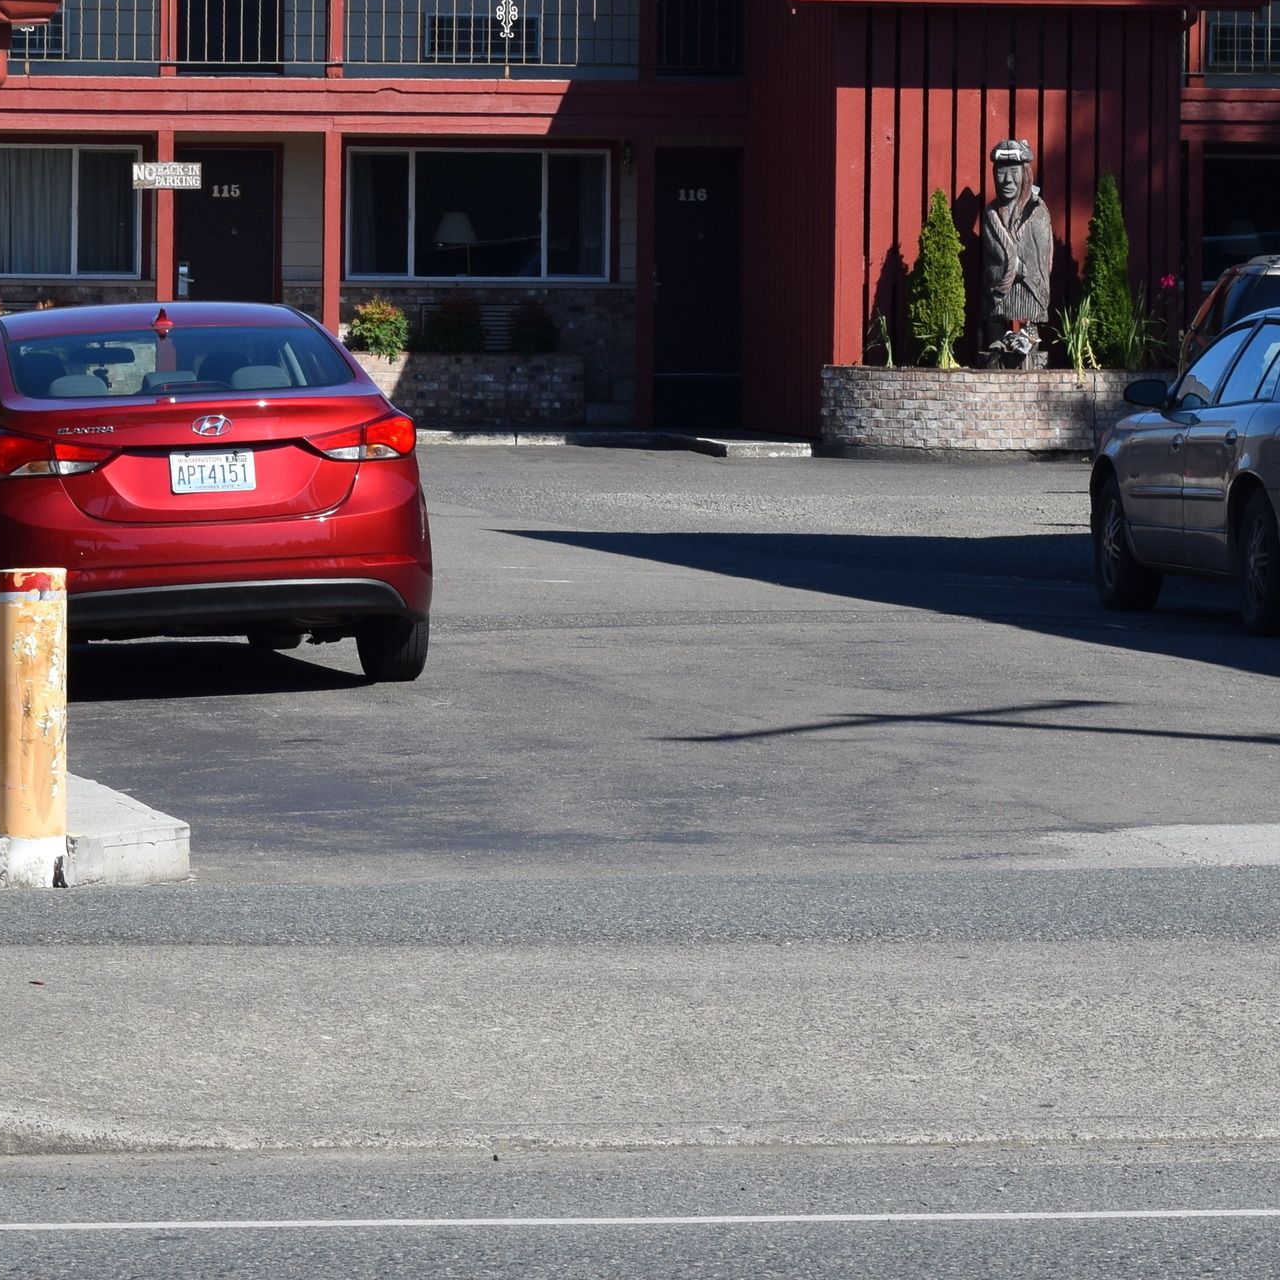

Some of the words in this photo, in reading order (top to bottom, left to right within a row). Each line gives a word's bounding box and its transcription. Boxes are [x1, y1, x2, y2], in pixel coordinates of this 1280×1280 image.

[133, 164, 157, 181] NO
[157, 164, 200, 175] BACK-IN
[155, 175, 201, 187] PARKING
[211, 184, 241, 198] 115
[676, 187, 708, 202] 116
[57, 425, 115, 435] ELANTRA
[177, 463, 248, 485] APT4151
